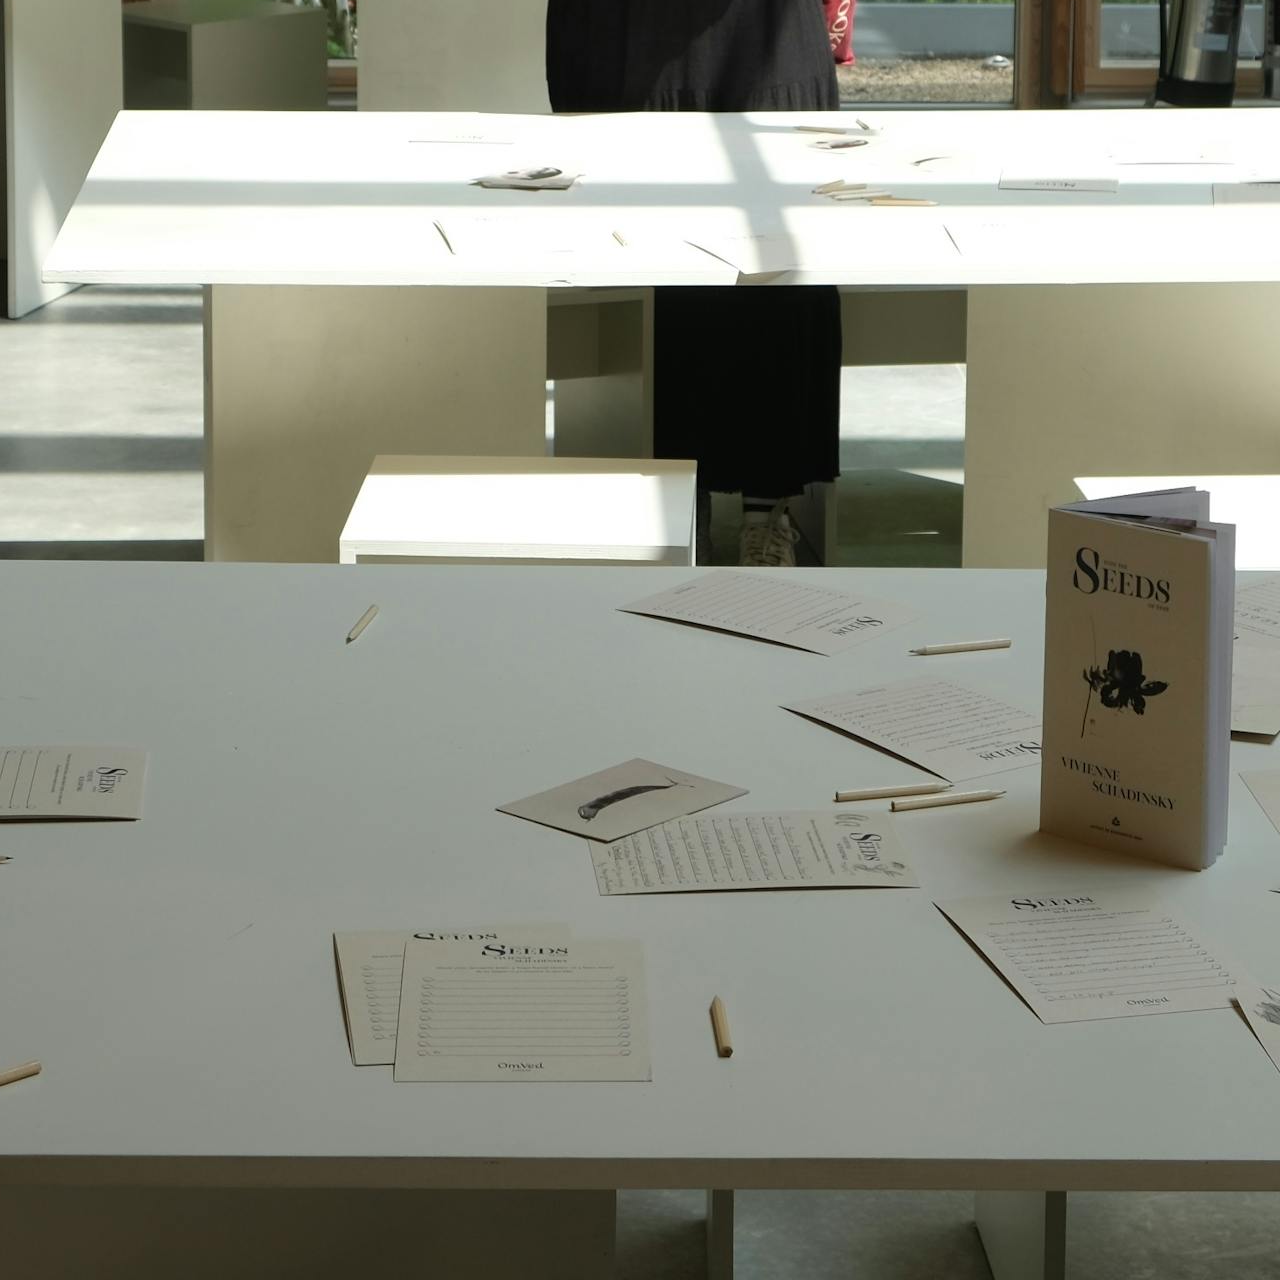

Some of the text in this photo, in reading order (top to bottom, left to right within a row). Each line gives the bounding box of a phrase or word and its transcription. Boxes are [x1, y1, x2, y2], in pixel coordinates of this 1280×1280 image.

[1073, 547, 1171, 604] SEEDS
[1062, 756, 1120, 783] VIVIENNE
[1092, 780, 1177, 811] SCHADINSKY
[850, 832, 882, 862] SEEDS
[1011, 897, 1094, 910] SEEDS
[481, 944, 569, 957] SEEDS
[1127, 996, 1169, 1007] OmVed
[497, 1062, 544, 1070] OmVed
